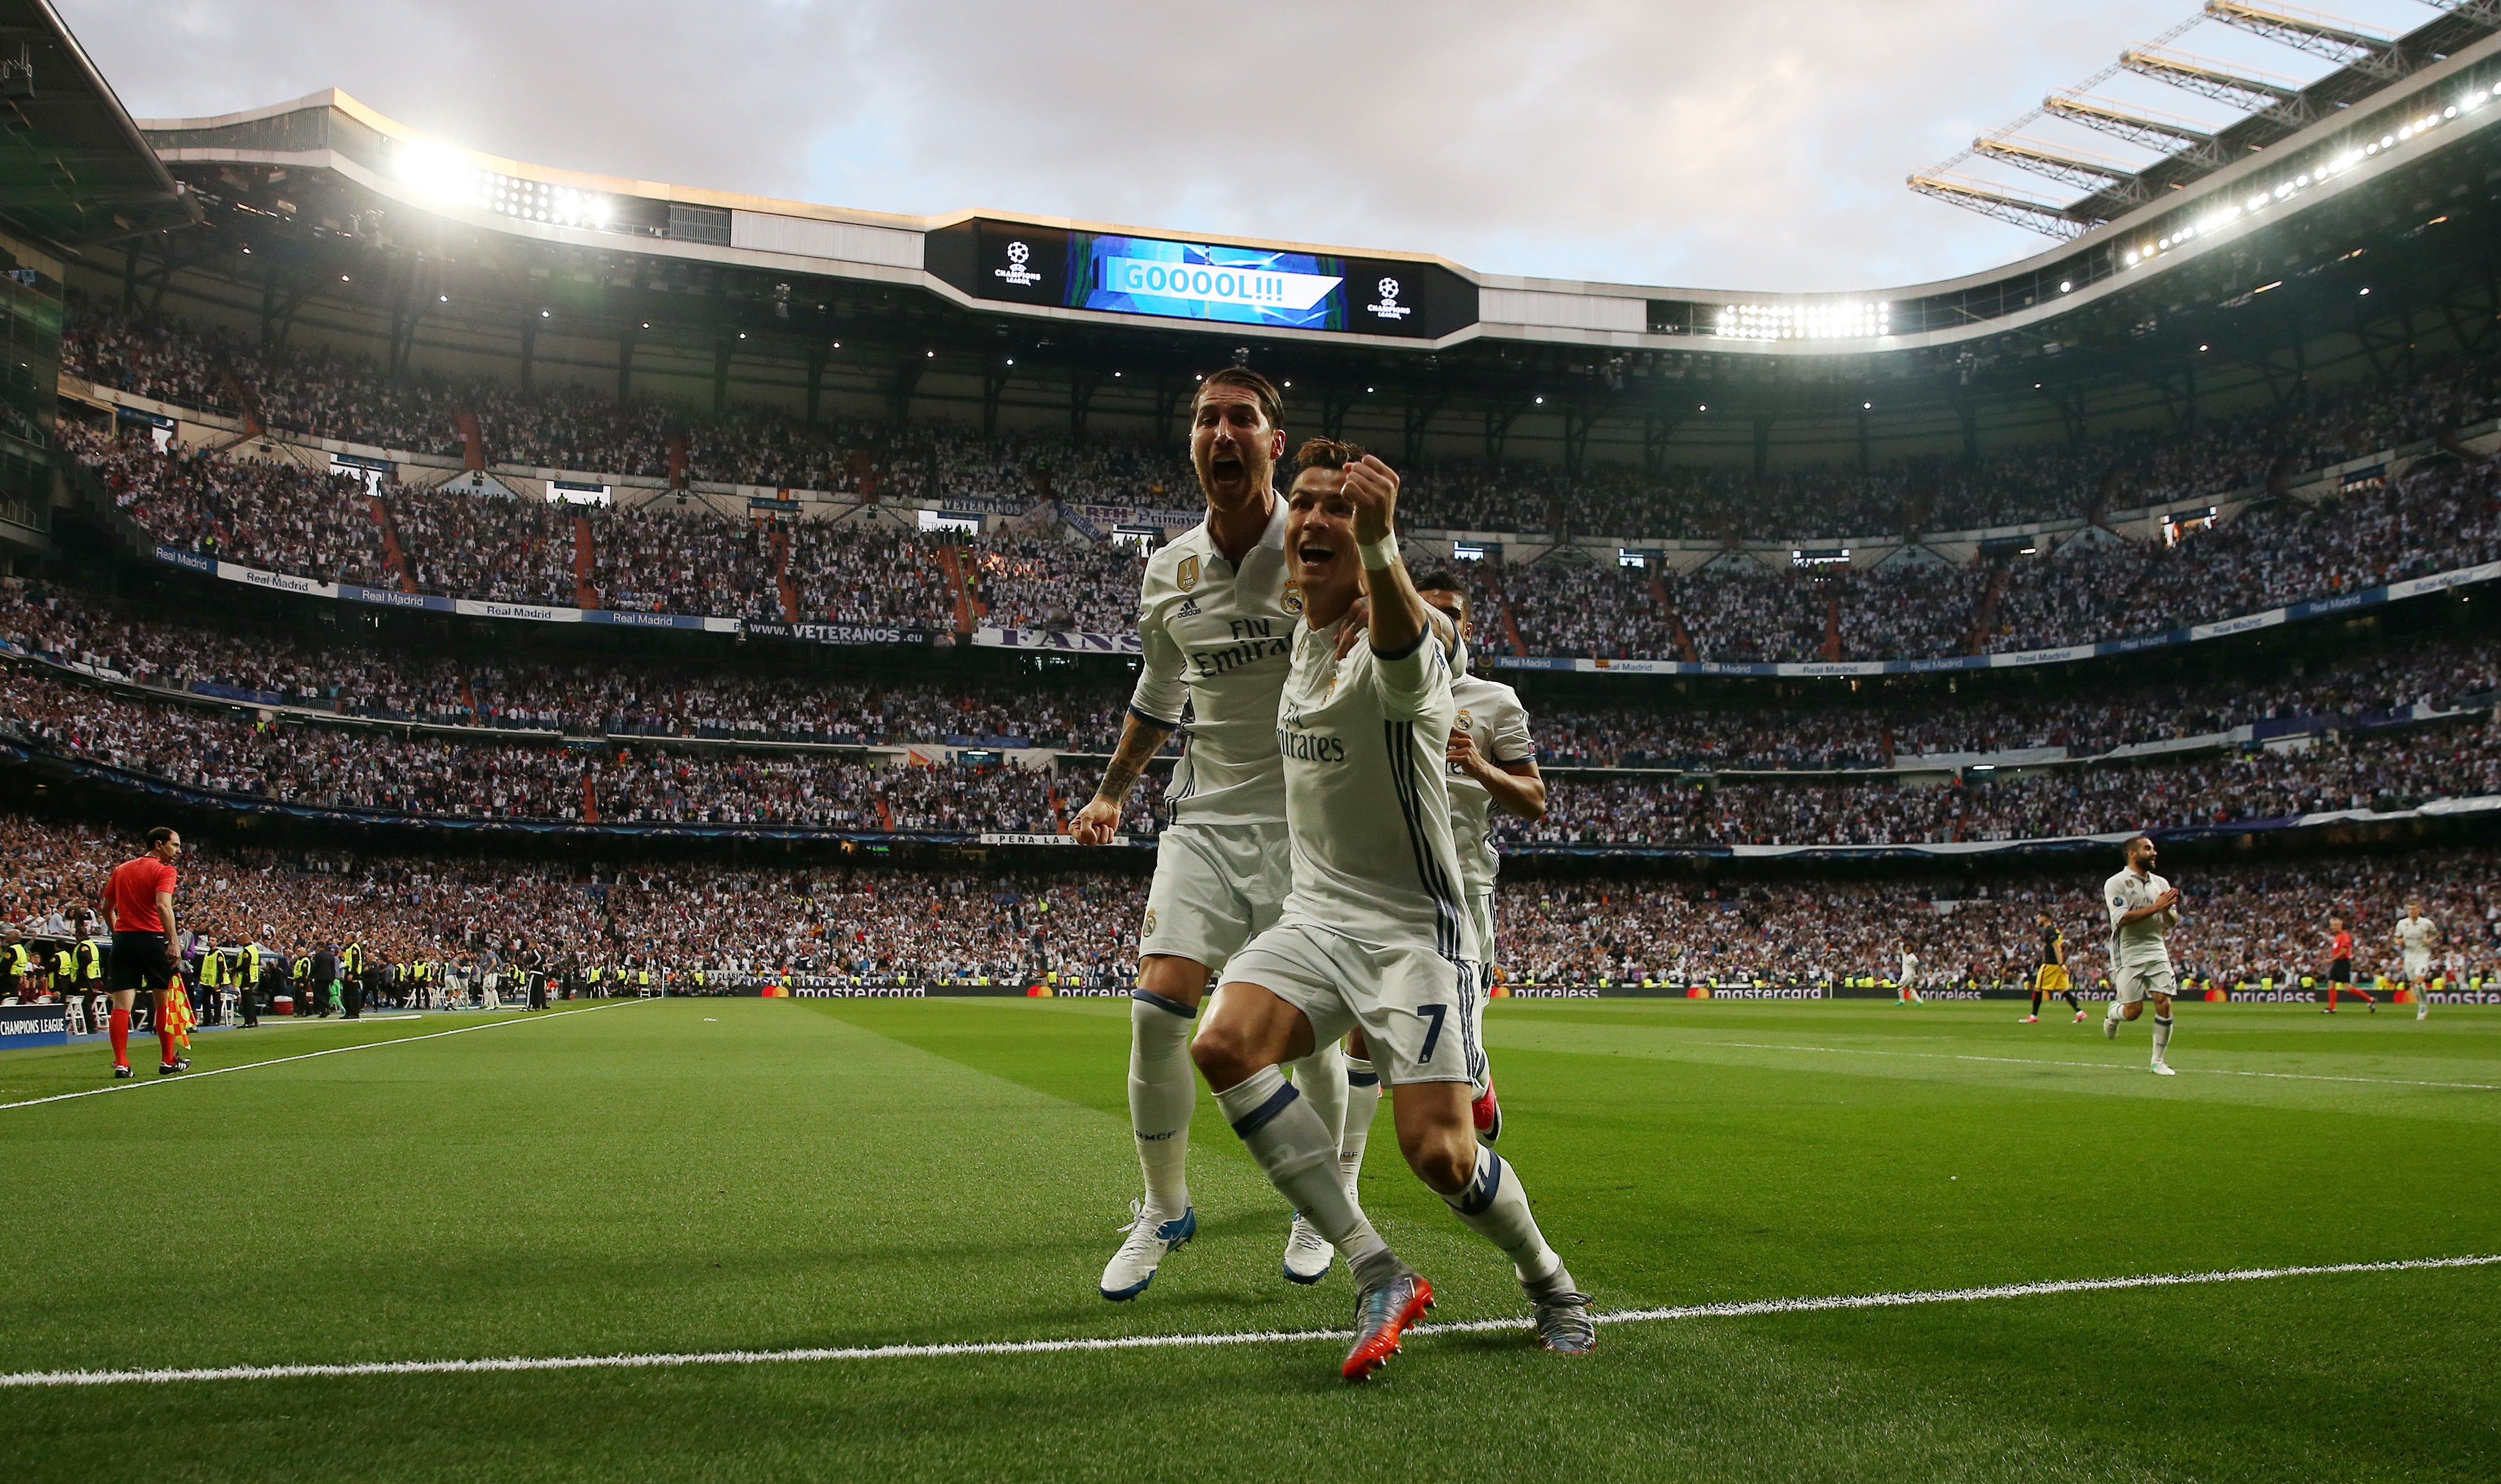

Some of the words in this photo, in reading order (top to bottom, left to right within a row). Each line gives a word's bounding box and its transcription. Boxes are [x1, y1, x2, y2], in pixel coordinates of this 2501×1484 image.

[995, 269, 1041, 281] CHAMPIONS
[1124, 264, 1282, 302] GOOOOL!!!
[156, 548, 175, 561] Real
[178, 553, 207, 570] Madrid
[247, 572, 269, 584] Real
[273, 576, 308, 591] Madrid
[363, 590, 384, 601] Real
[388, 594, 423, 606] Madrid
[487, 606, 511, 615] Real
[515, 608, 551, 619] Madrid
[1178, 608, 1202, 618] adidas
[613, 613, 635, 623] Real
[639, 615, 673, 626] Madrid
[750, 623, 788, 635] www.
[793, 624, 900, 642] VETERANOS
[1229, 618, 1270, 640] Fly
[1191, 631, 1294, 678] Emira
[1501, 658, 1520, 666] Real
[1522, 659, 1551, 667] Madrid
[1623, 662, 1652, 671] Madrid
[1826, 665, 1858, 674] Madrid
[1277, 723, 1344, 762] mirates
[796, 985, 925, 997] mastercard
[1059, 985, 1137, 997] priceles
[1516, 986, 1599, 998] priceless
[1715, 986, 1822, 999] mastercard
[1921, 989, 1981, 1000] priceless
[2230, 989, 2316, 1003] priceless
[2426, 990, 2501, 1004] maste
[0, 1020, 39, 1036] CHAMPIONS
[40, 1018, 64, 1033] LEAGUE
[1418, 1004, 1447, 1064] 7
[1136, 1130, 1176, 1140] RMCF
